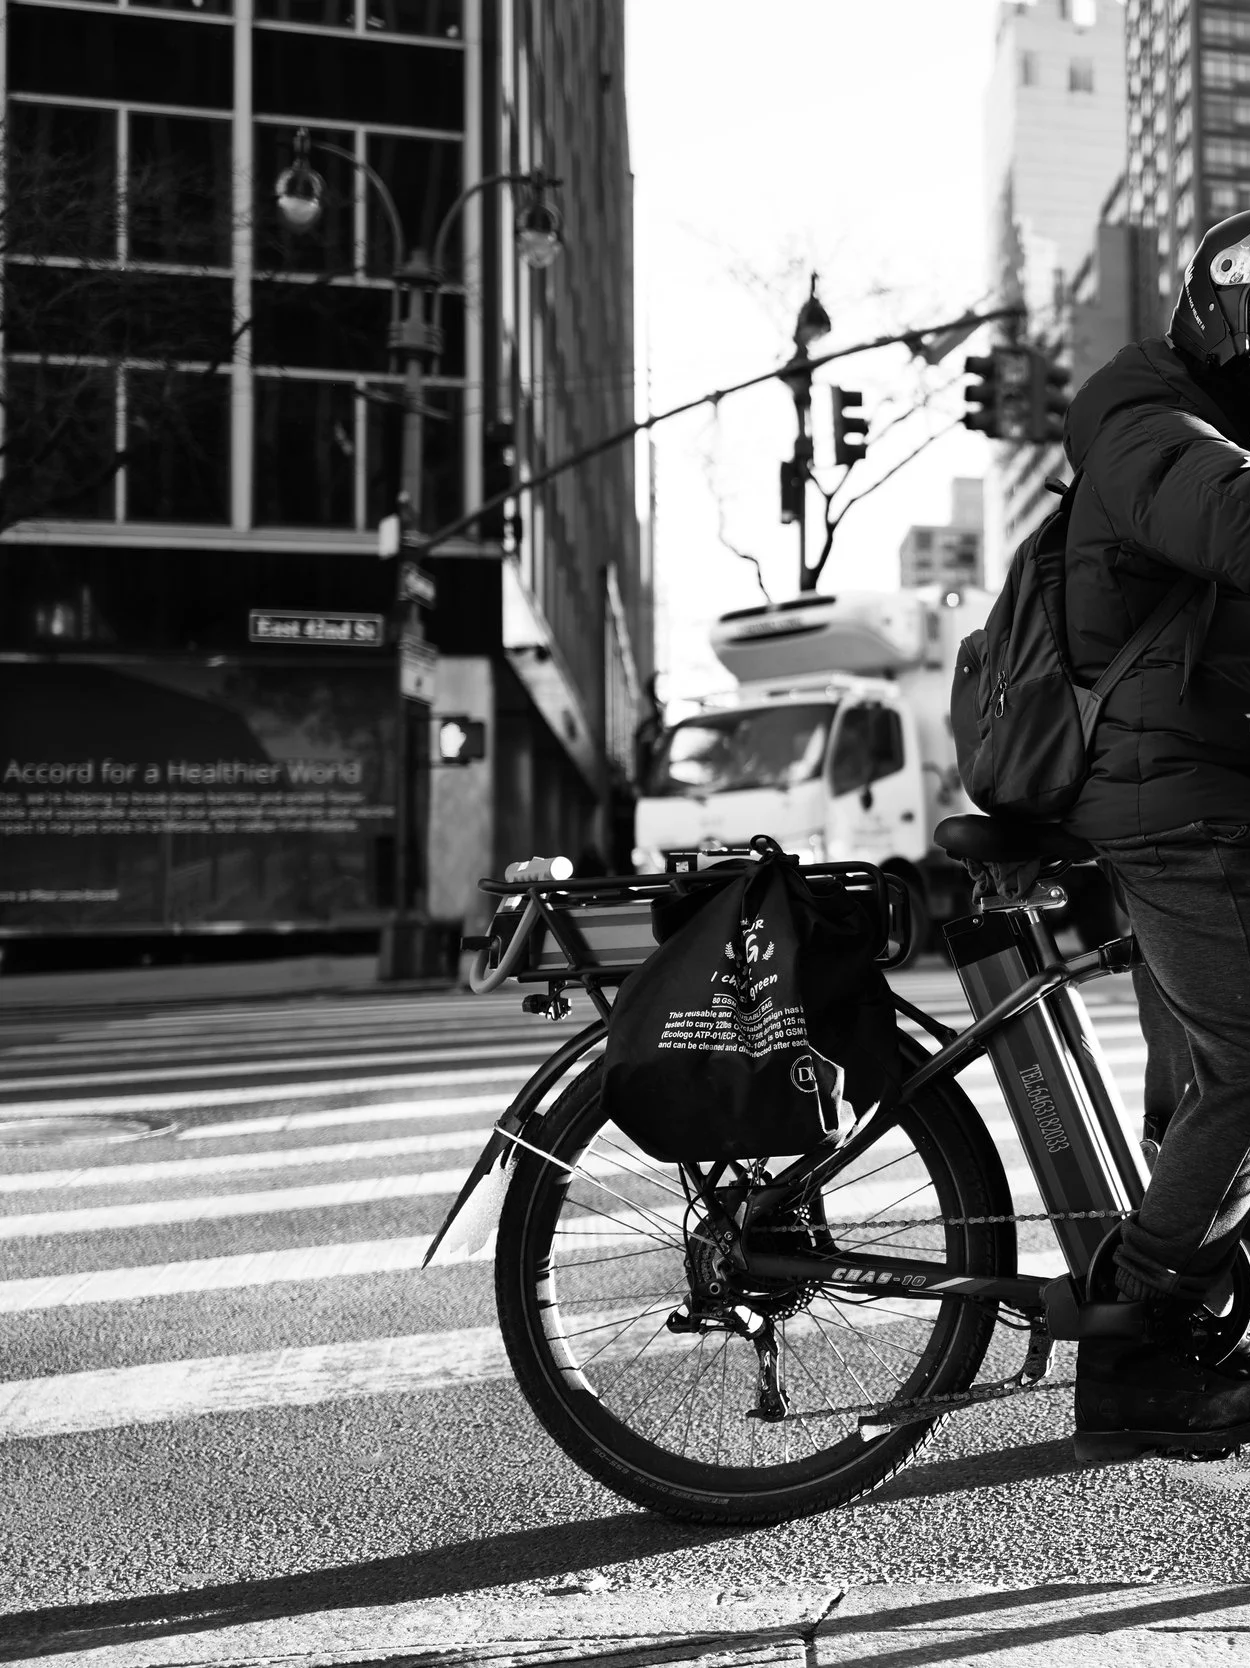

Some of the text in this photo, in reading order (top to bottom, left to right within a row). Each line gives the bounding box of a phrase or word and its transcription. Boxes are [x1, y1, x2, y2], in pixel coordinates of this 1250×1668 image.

[256, 617, 376, 640] East 42nd St
[3, 757, 363, 785] Accord for a Healthier World
[710, 970, 718, 982] I
[750, 974, 778, 1001] green
[669, 1011, 684, 1020] This
[684, 1009, 717, 1018] reusable
[718, 1010, 733, 1018] and
[784, 1006, 799, 1015] has
[721, 997, 737, 1007] GSM
[761, 1000, 773, 1013] BAG
[665, 1020, 686, 1029] tested
[694, 1021, 714, 1031] carry
[783, 1016, 796, 1026] 125
[661, 1030, 694, 1040] (Ecologo
[774, 1030, 784, 1039] 80
[785, 1027, 804, 1037] GSM
[658, 1041, 672, 1049] and
[687, 1041, 697, 1050] be
[698, 1042, 725, 1051] cleaned
[724, 1043, 738, 1052] and
[773, 1041, 790, 1050] after
[1019, 1063, 1070, 1153] TEL:6463182033
[831, 1267, 927, 1287] CHAS-10
